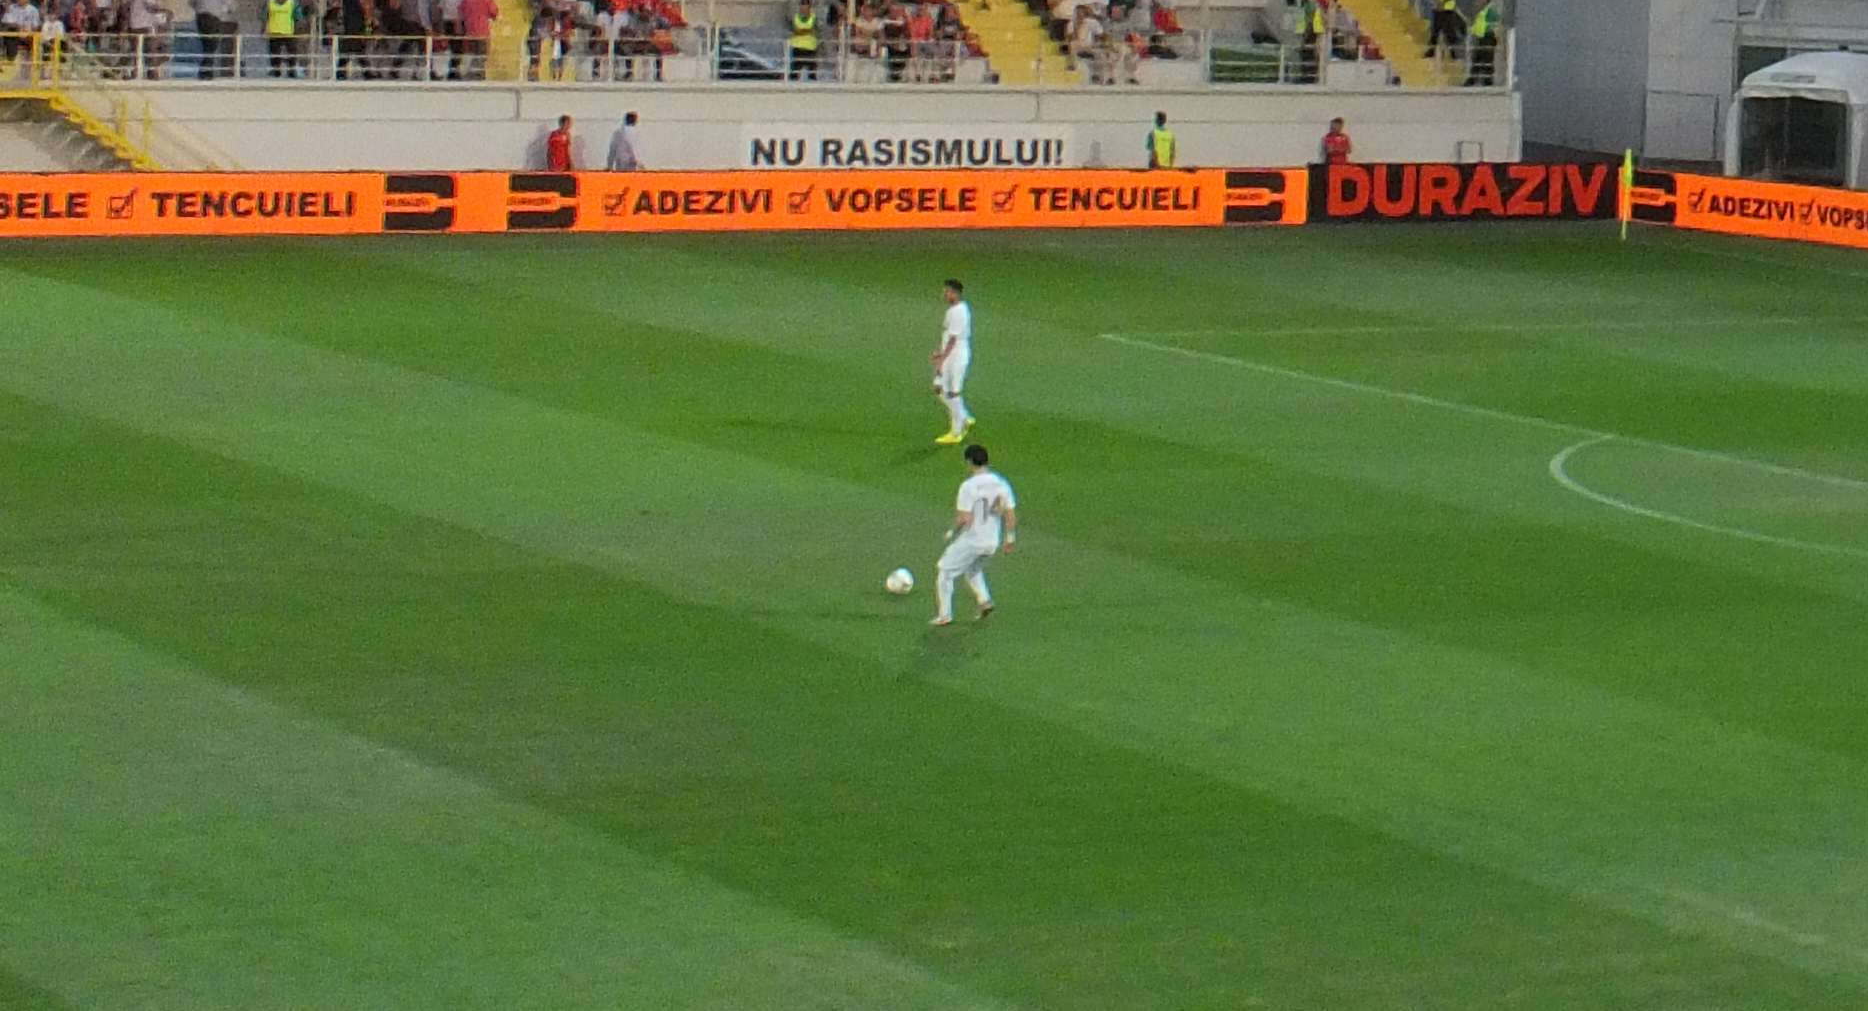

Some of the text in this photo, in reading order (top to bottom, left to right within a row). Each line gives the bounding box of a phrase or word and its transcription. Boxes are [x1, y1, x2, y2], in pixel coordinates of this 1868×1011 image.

[750, 138, 1064, 166] NU RASISMULUI!
[632, 187, 1201, 216] ADEZIVI VOPSELE TENCUIELI
[1326, 164, 1606, 217] DURAZIV
[151, 192, 357, 218] TENCUIELI
[1708, 194, 1794, 221] ADEZIVI
